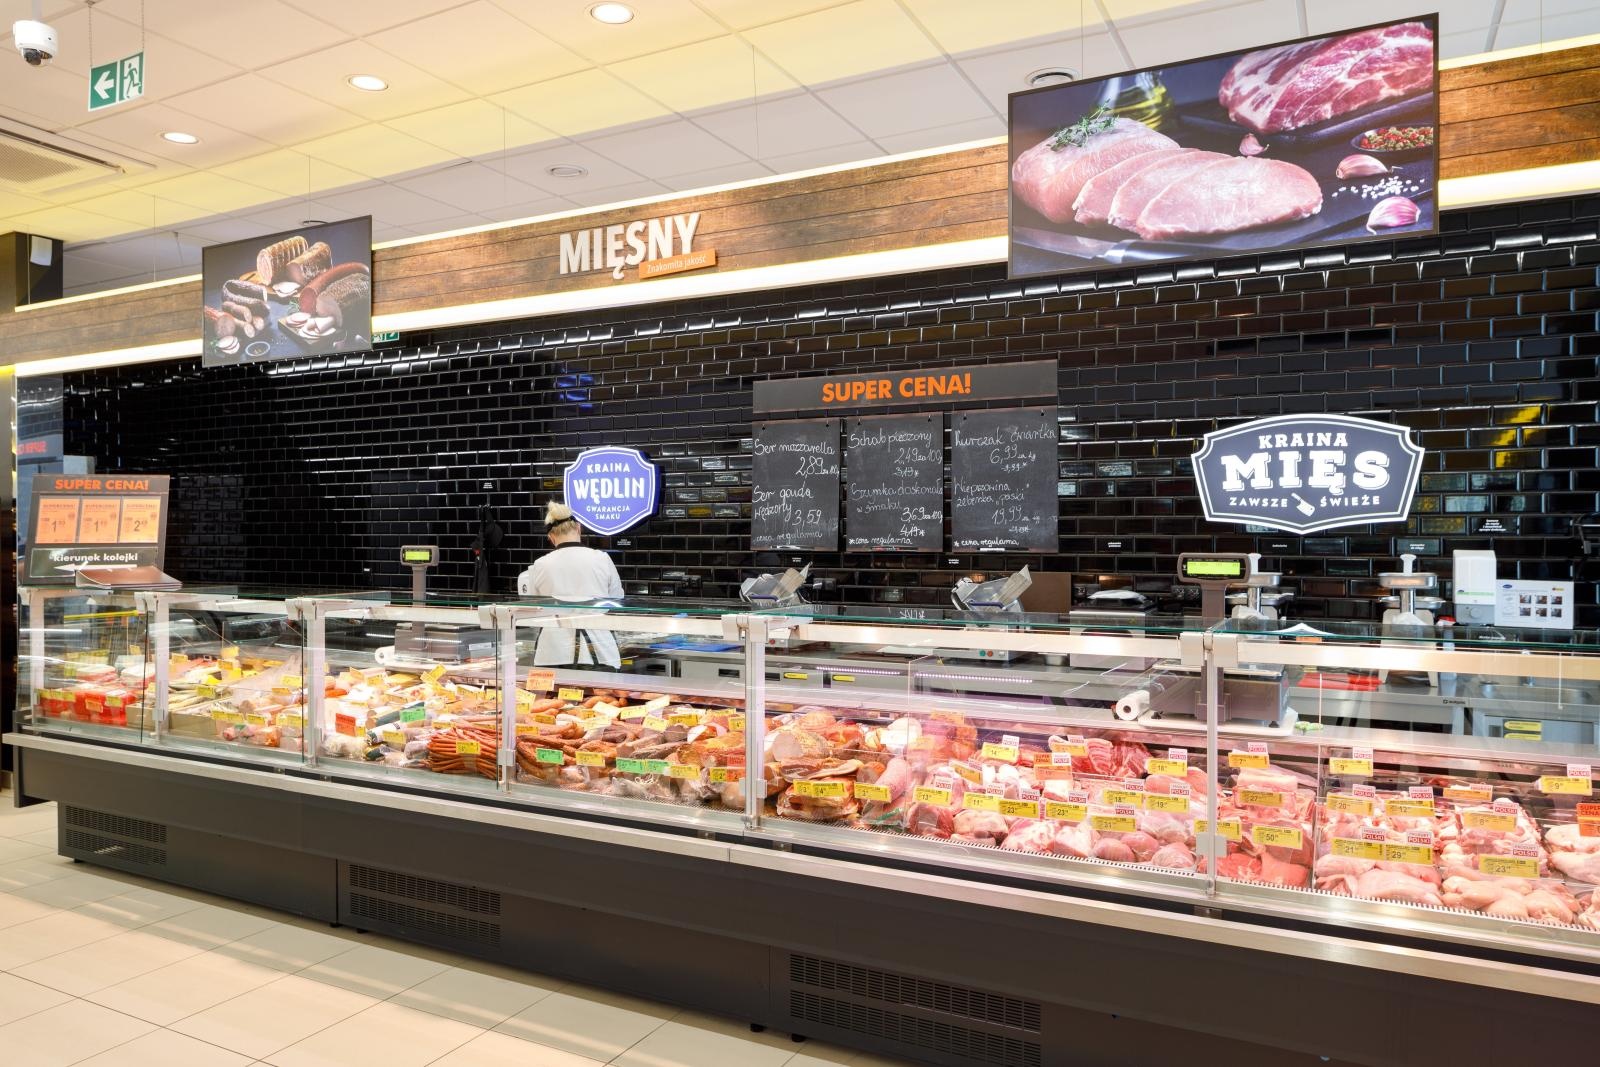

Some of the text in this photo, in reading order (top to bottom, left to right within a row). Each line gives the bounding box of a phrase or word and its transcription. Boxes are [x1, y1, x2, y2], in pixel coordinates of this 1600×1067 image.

[559, 212, 701, 280] MIĘSNY
[822, 373, 972, 403] SUPER CENA!
[848, 428, 886, 449] Schab
[954, 427, 1005, 447] Kurczak
[1258, 432, 1349, 449] KRAINA
[754, 439, 836, 455] Ser mozzarella
[586, 463, 631, 474] KRAINA
[1220, 450, 1390, 495] MIĘS
[55, 479, 149, 490] SUPER CENA!
[572, 477, 646, 504] WĘDLIN
[752, 485, 775, 503] Ser
[1229, 494, 1381, 508] ZAWSZE ŚWIEŻE
[586, 505, 631, 513] GWARANCJA
[792, 509, 822, 529] 3,59
[52, 553, 138, 563] kierunek kolejki
[1495, 807, 1517, 815] POLSKI
[1408, 836, 1431, 844] POLSKI
[1513, 849, 1537, 857] POLSKI
